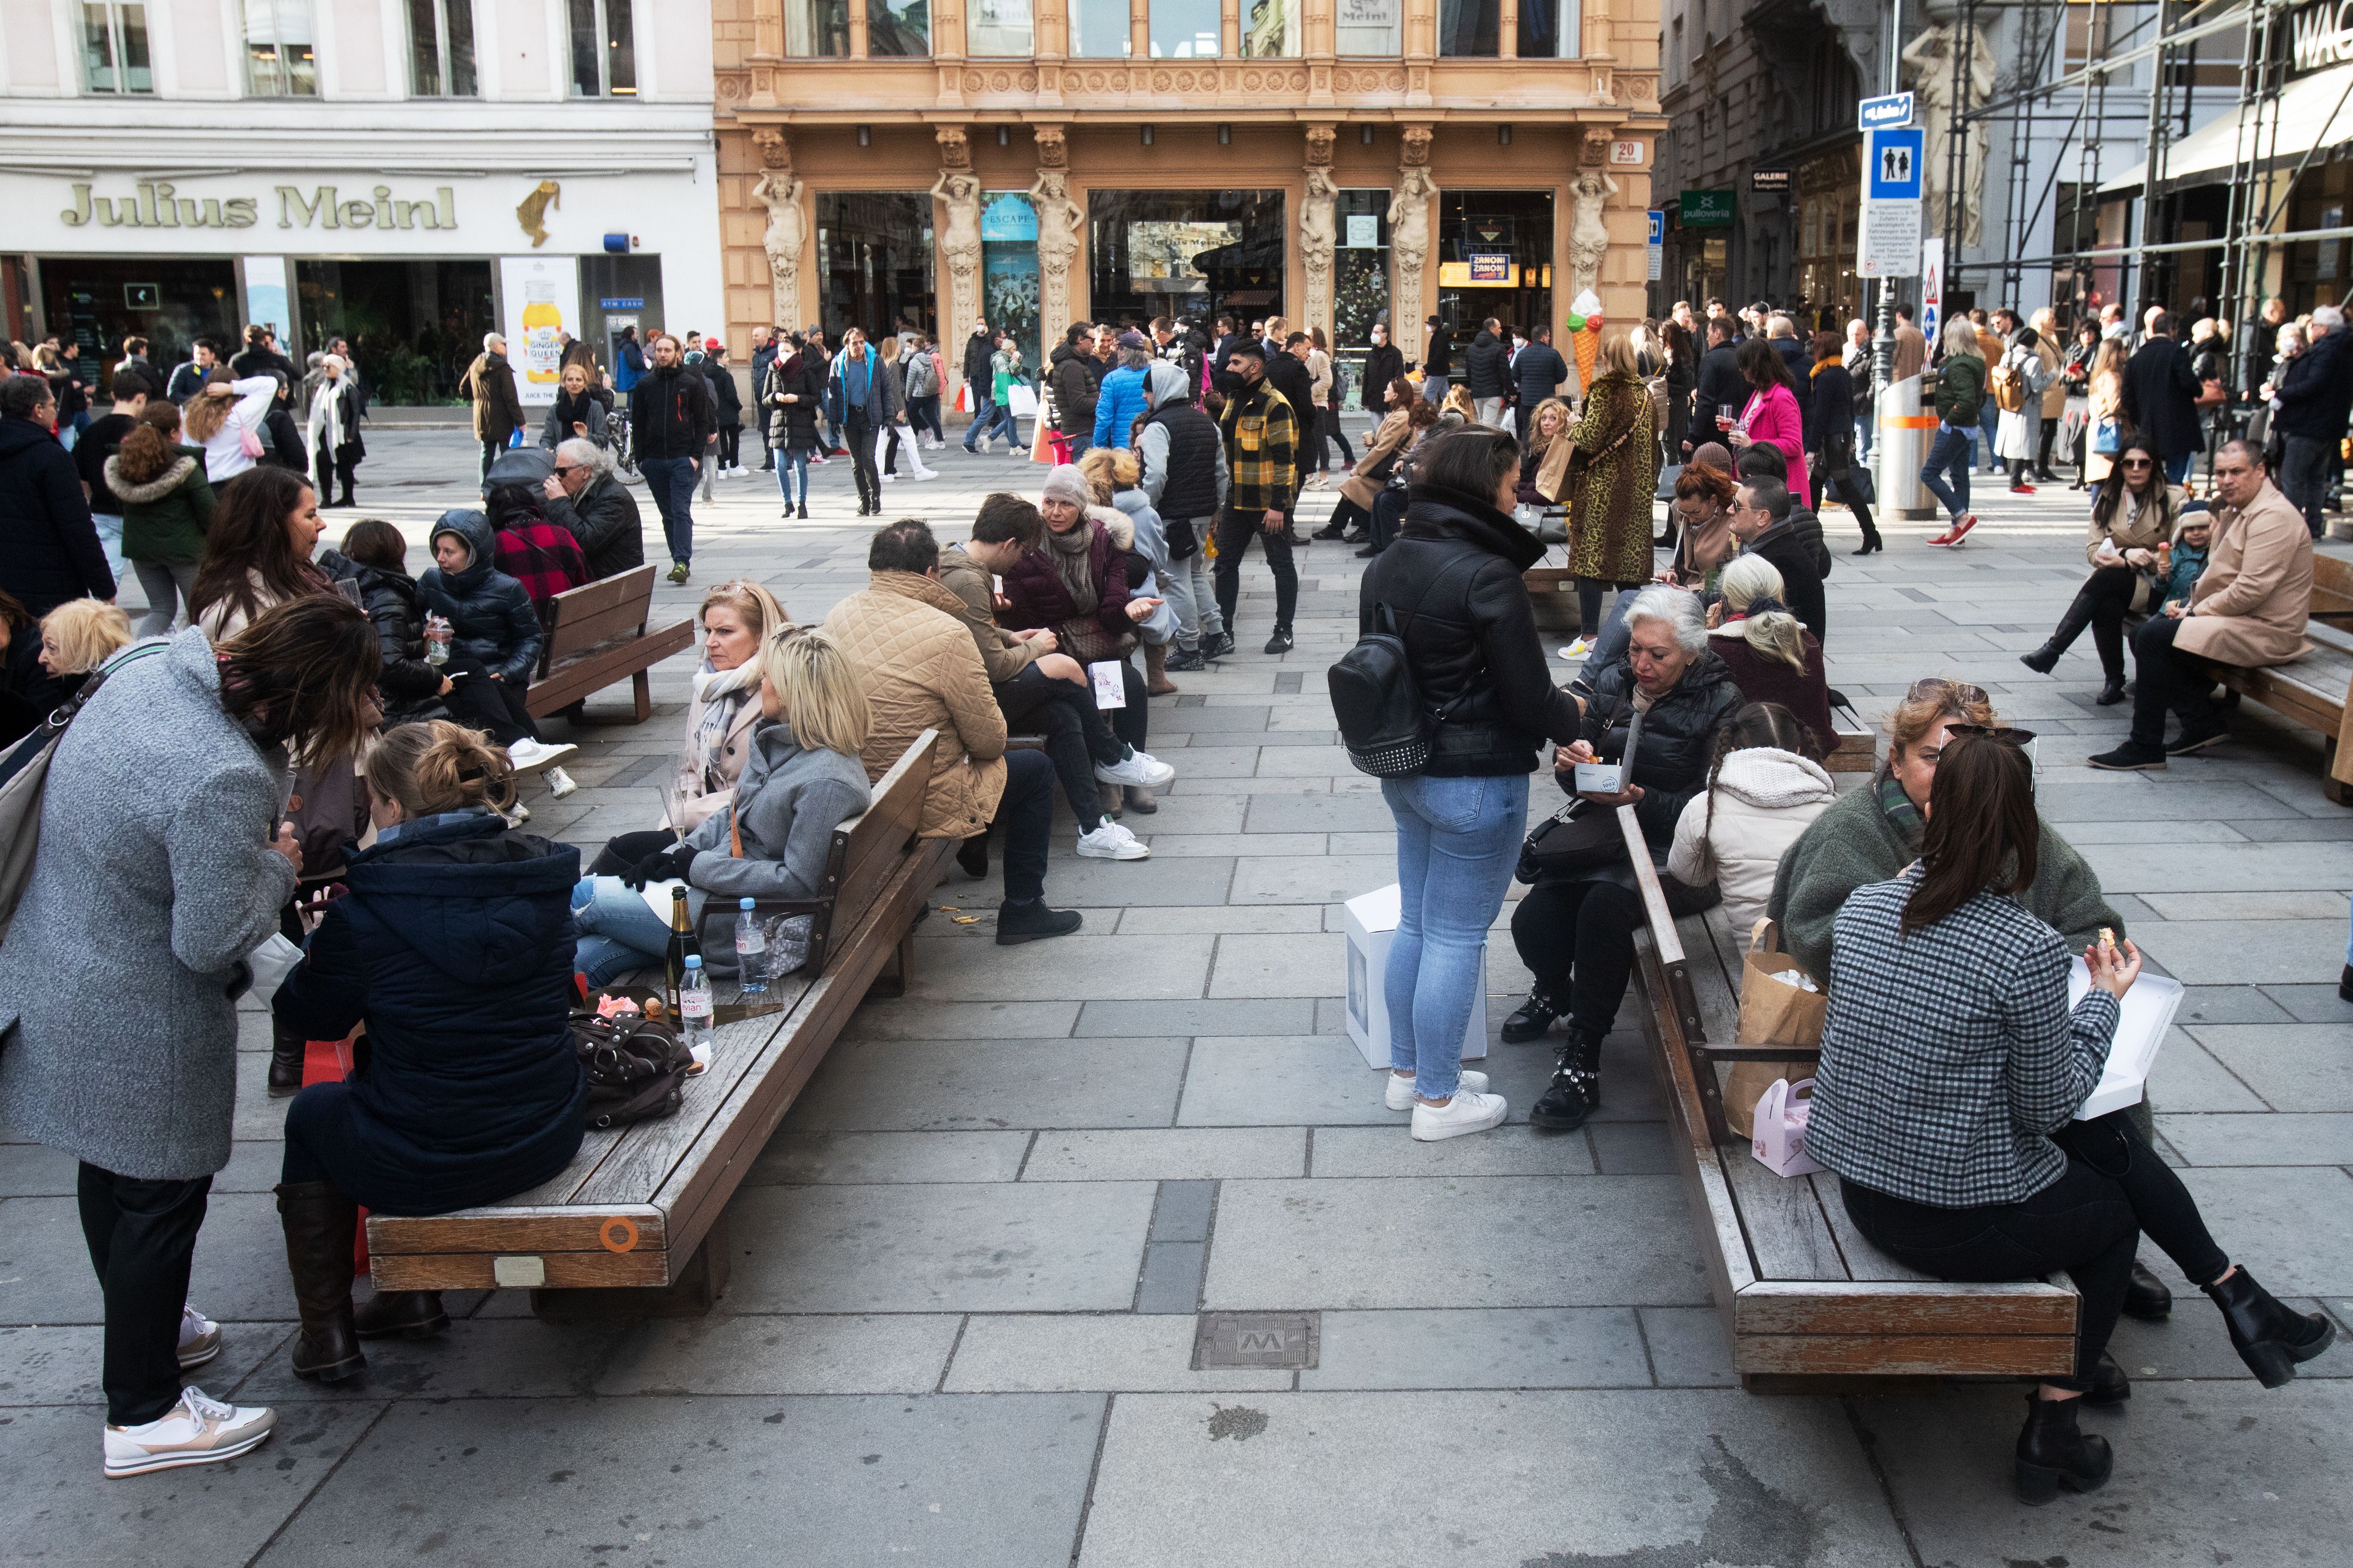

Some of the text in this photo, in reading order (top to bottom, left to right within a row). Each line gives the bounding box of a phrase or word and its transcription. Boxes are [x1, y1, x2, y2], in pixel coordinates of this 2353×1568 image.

[1618, 142, 1634, 156] 20
[1753, 172, 1788, 181] GALERIE
[60, 183, 458, 229] Julius Meinl
[1684, 209, 1730, 219] pulloveria
[989, 215, 1029, 223] ESCAPE
[531, 349, 560, 358] QUEEN
